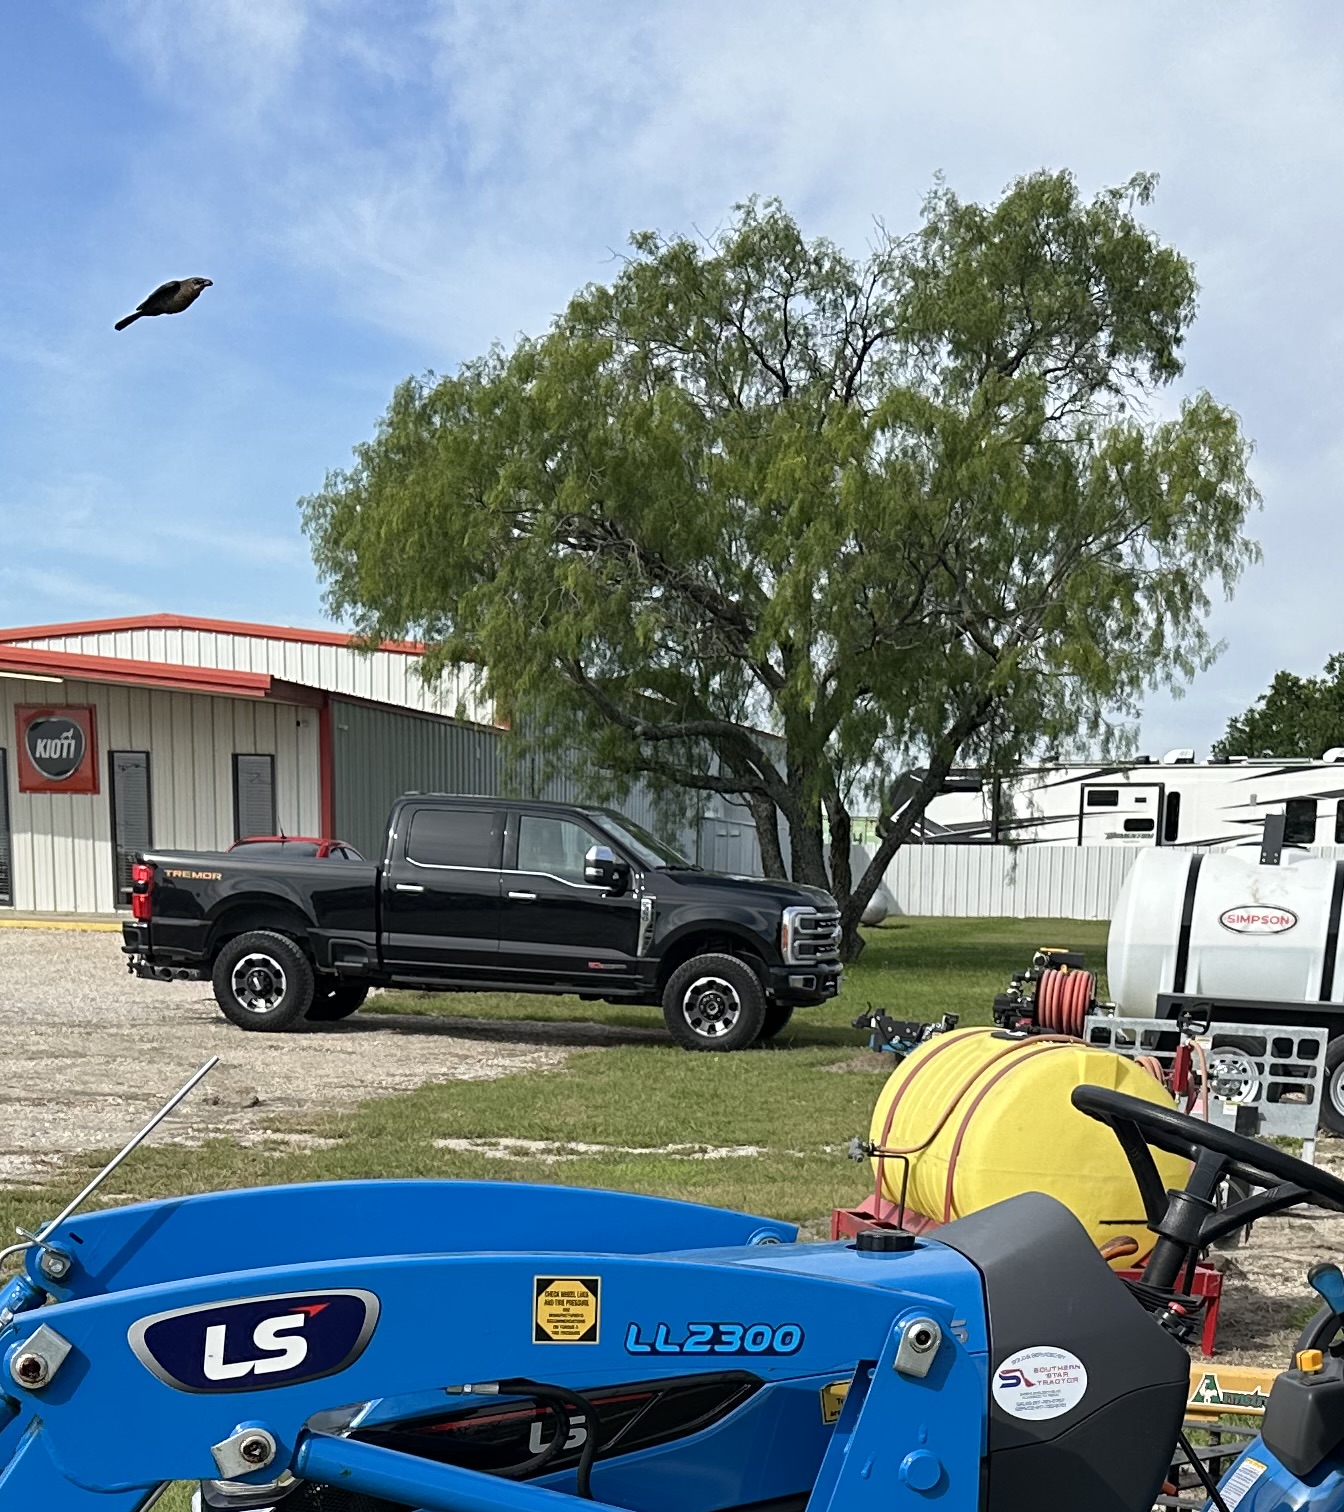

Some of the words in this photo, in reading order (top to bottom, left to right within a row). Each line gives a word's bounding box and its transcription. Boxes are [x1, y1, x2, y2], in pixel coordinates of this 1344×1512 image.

[36, 739, 75, 759] KIOTI
[164, 869, 223, 880] TREMOR
[1226, 914, 1290, 925] SIMPSON
[626, 1324, 802, 1353] LL2300
[203, 1313, 308, 1381] LS
[1034, 1364, 1081, 1374] SOUTHERN
[1037, 1377, 1079, 1386] TRACTOR
